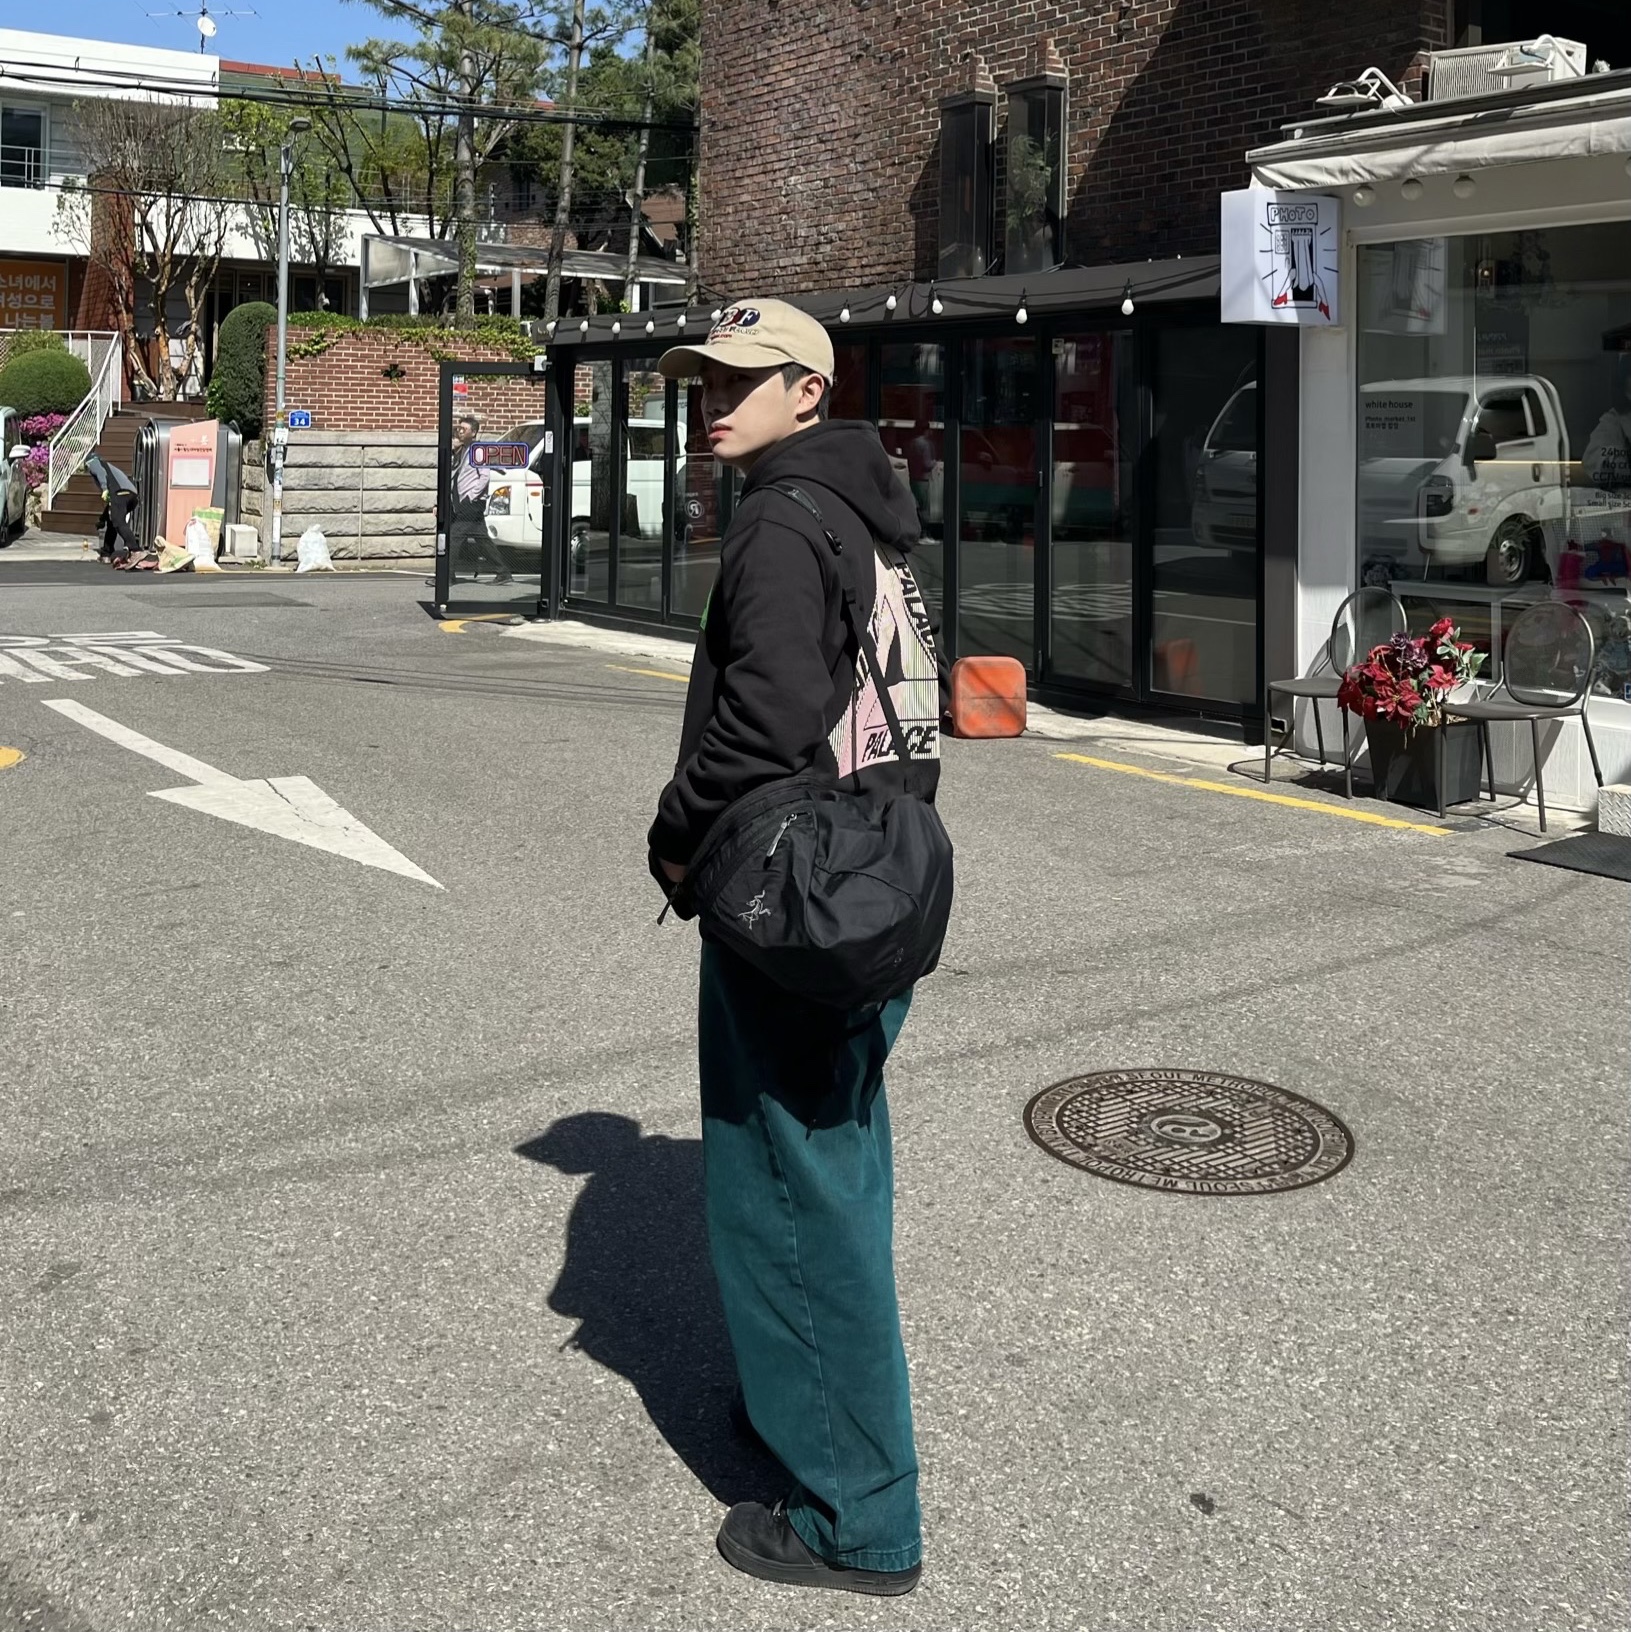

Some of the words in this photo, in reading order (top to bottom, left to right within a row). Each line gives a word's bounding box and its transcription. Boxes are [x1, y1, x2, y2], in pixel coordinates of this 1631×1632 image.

[1270, 207, 1316, 222] PHOTO
[1365, 400, 1387, 408] white
[1388, 400, 1413, 408] house
[294, 417, 305, 426] 34
[473, 445, 526, 466] OPEN
